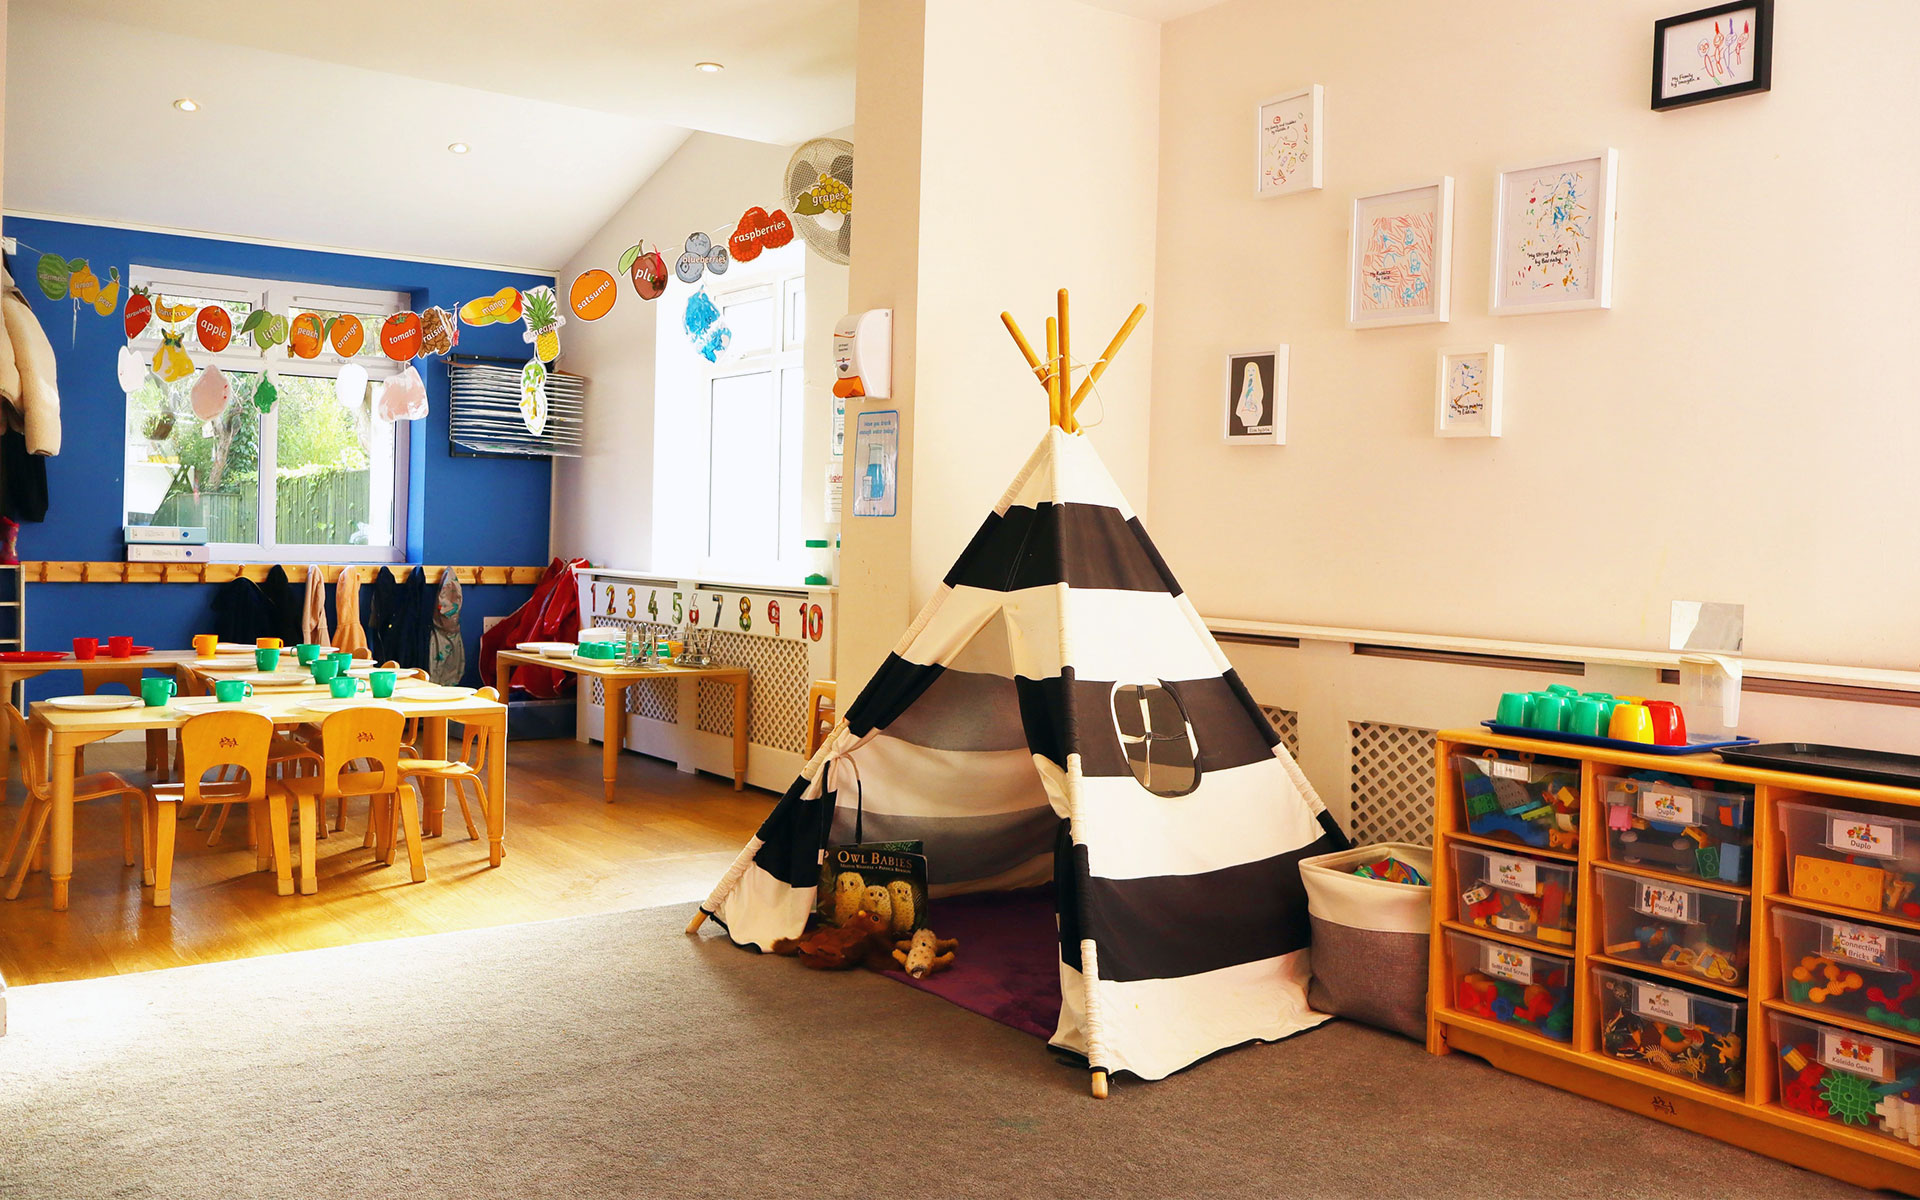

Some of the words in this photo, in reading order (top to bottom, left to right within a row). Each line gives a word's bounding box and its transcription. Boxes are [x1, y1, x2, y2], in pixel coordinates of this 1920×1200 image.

[812, 191, 845, 206] grapes
[734, 220, 786, 242] raspberries
[682, 255, 727, 264] blueberries
[74, 281, 94, 289] lemon
[98, 295, 113, 308] pear
[577, 279, 611, 311] satsuma
[482, 297, 507, 316] mango
[200, 317, 228, 339] apple
[262, 320, 283, 341] lime
[297, 327, 320, 340] peach
[337, 322, 359, 349] orange
[389, 327, 417, 345] tomato
[591, 583, 596, 613] 1
[606, 585, 616, 616] 2
[626, 587, 636, 618] 3
[648, 590, 659, 622] 4
[672, 592, 683, 625] 5
[688, 593, 699, 626] 6
[712, 594, 723, 628] 7
[739, 596, 752, 632] 8
[767, 600, 780, 637] 9
[799, 602, 824, 642] 10
[1657, 808, 1676, 817] Duplo
[1850, 839, 1872, 850] Duplo
[838, 850, 867, 863] OWL
[872, 852, 912, 868] BABIES
[1500, 878, 1522, 888] Vehicles
[1655, 901, 1673, 913] People
[1840, 938, 1880, 954] Connecting
[1848, 950, 1870, 961] Bricks
[1650, 1005, 1674, 1017] Animals
[1832, 1056, 1855, 1068] Kaleido
[1855, 1062, 1874, 1073] Gears
